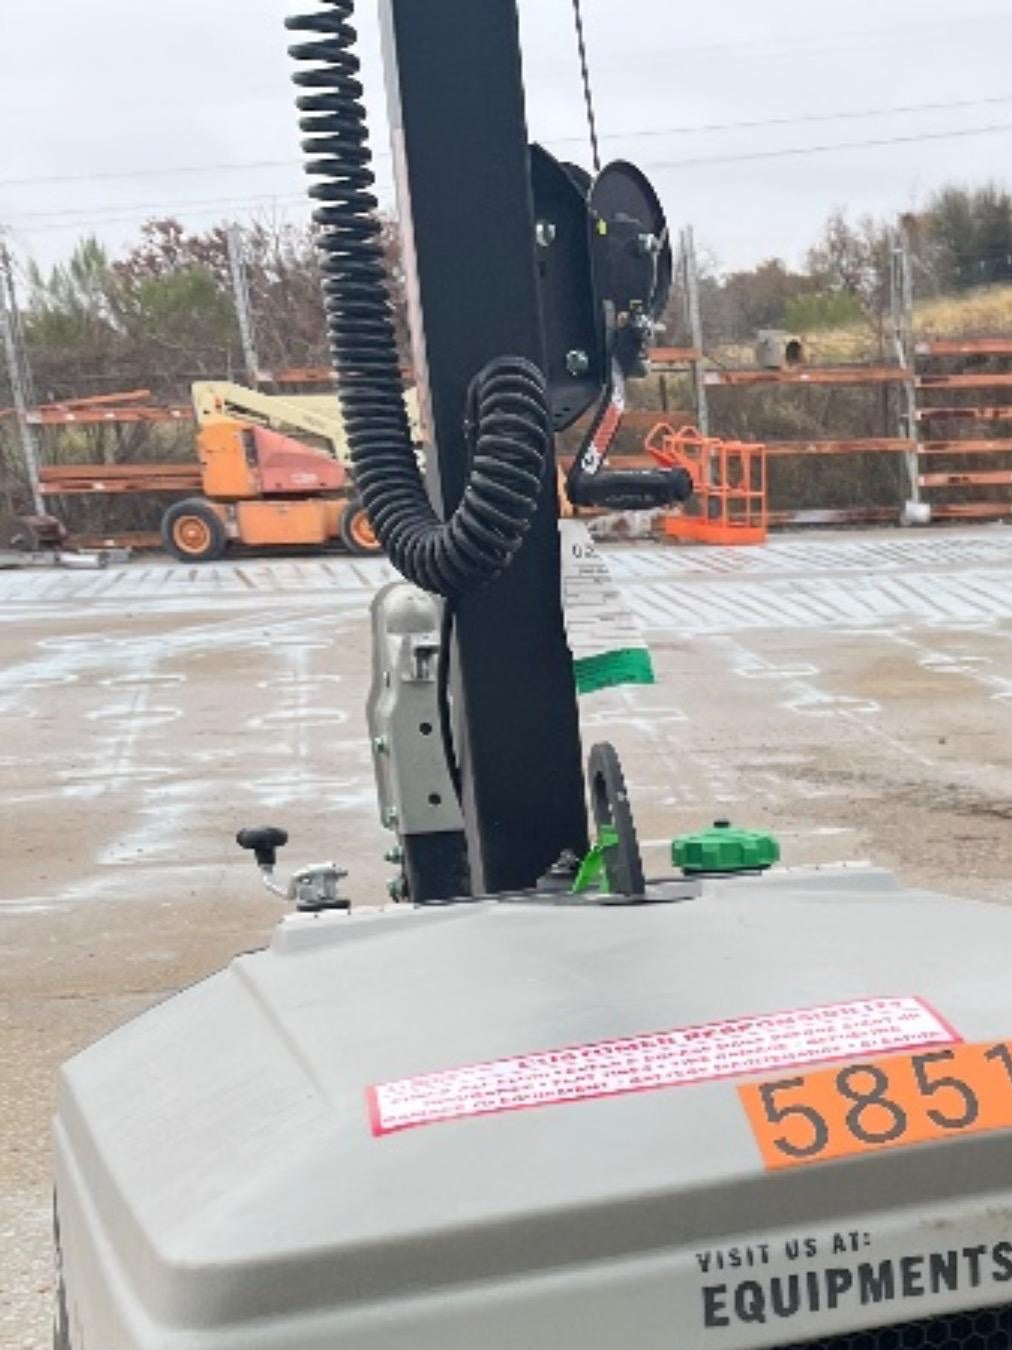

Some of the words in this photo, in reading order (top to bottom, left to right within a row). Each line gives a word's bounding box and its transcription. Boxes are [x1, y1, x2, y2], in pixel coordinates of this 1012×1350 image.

[696, 1242, 771, 1273] VISIT
[785, 1237, 819, 1261] US
[831, 1232, 873, 1255] AT:
